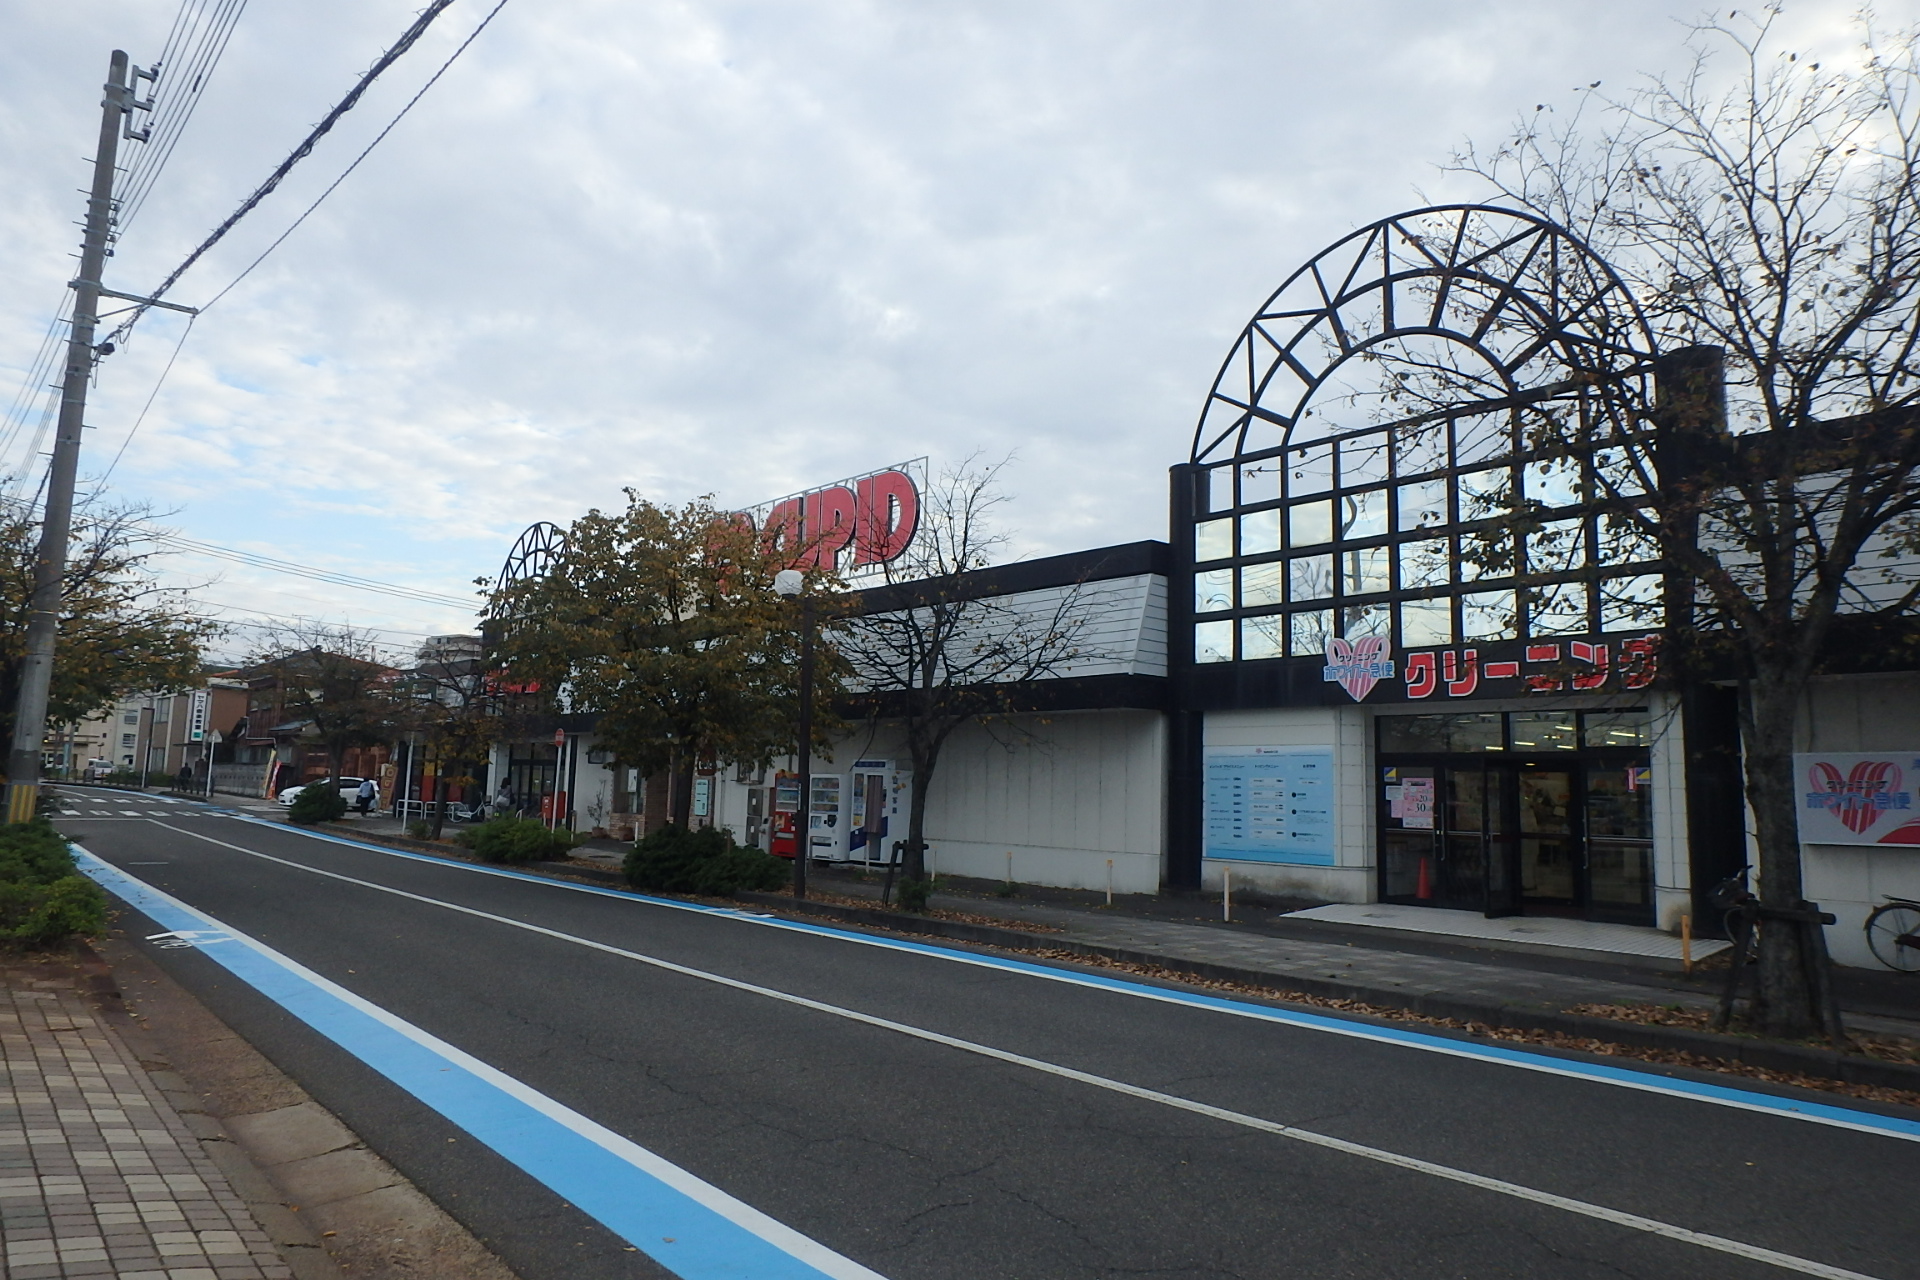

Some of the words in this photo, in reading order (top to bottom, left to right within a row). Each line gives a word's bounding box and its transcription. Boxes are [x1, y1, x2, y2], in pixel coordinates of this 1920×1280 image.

[1338, 652, 1379, 663] クリーニング
[1405, 634, 1661, 698] クリーニング
[1324, 662, 1394, 680] ホワイト急便
